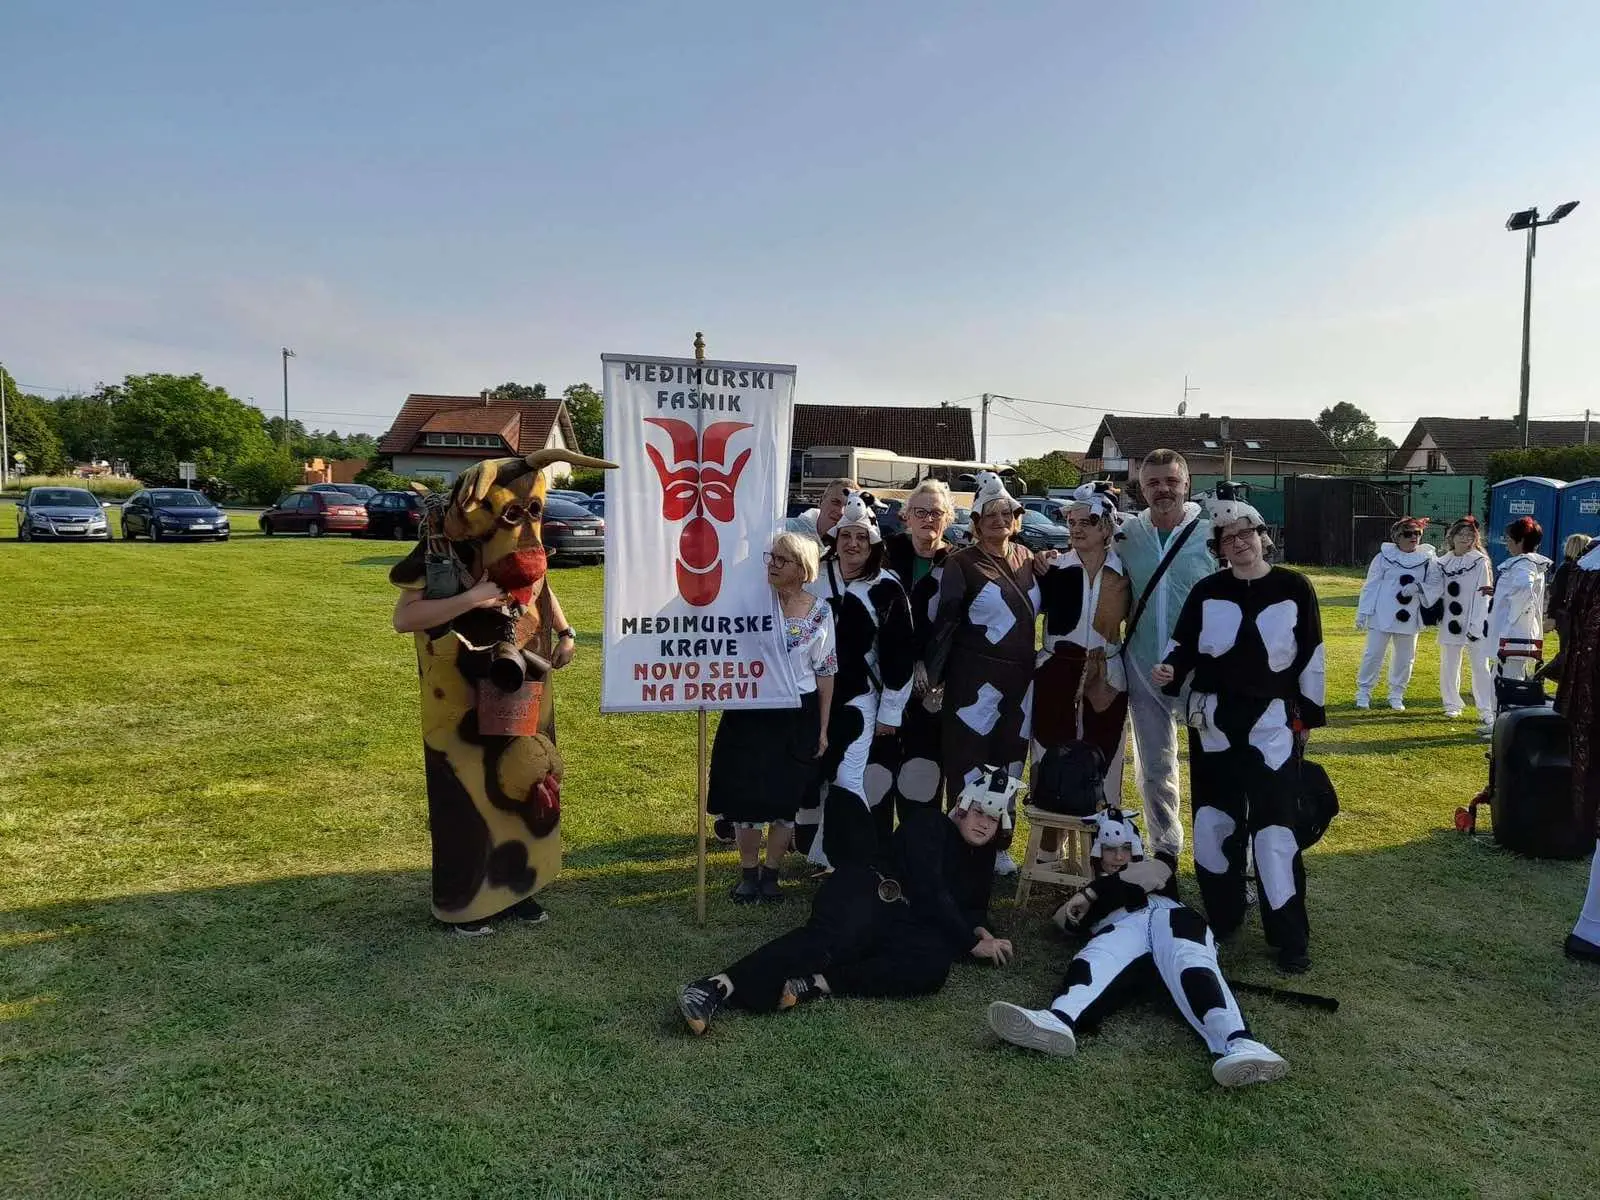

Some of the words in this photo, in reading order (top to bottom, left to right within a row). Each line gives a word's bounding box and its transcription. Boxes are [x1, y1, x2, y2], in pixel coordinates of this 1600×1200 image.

[625, 363, 775, 390] MEĐIMURSKI
[657, 388, 742, 412] FAŠNIK
[622, 615, 773, 635] MEĐIMURSKE
[660, 638, 738, 658] KRAVE
[634, 661, 700, 681] NOVO
[709, 660, 765, 680] SELO
[642, 683, 674, 702] NA
[684, 682, 758, 702] DRAVI
